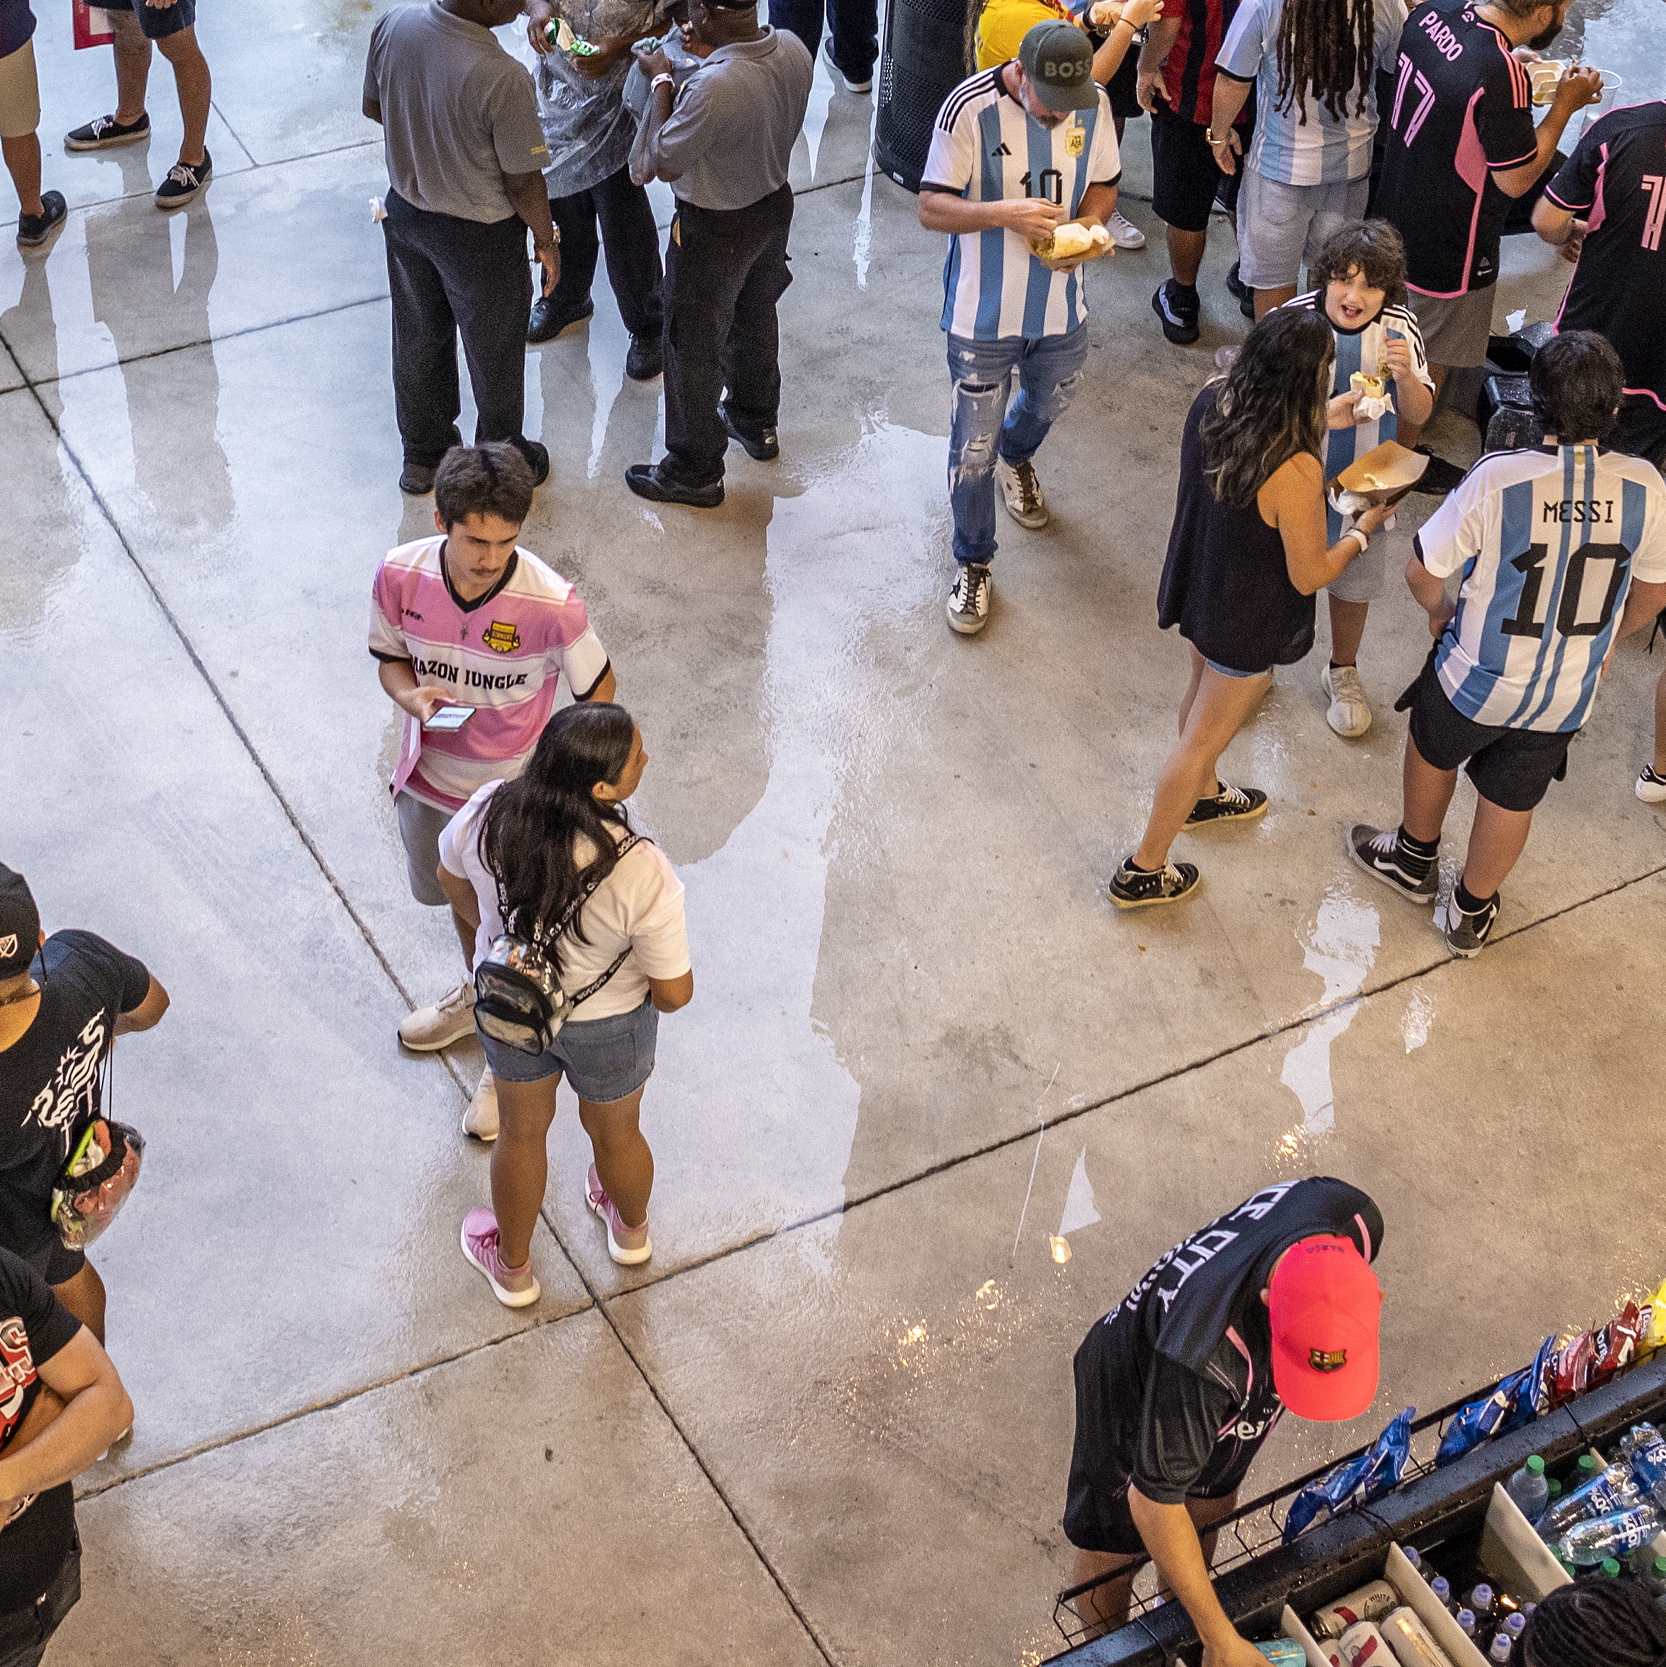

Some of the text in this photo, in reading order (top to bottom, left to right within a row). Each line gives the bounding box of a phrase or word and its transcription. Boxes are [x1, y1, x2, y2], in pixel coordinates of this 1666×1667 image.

[1418, 11, 1464, 62] PARDO
[1044, 59, 1093, 79] BOSS
[1390, 51, 1436, 148] 17
[1542, 500, 1614, 523] MESSI
[1501, 542, 1632, 638] 10
[464, 668, 529, 690] JUNGLE
[1158, 1229, 1239, 1313] CITY
